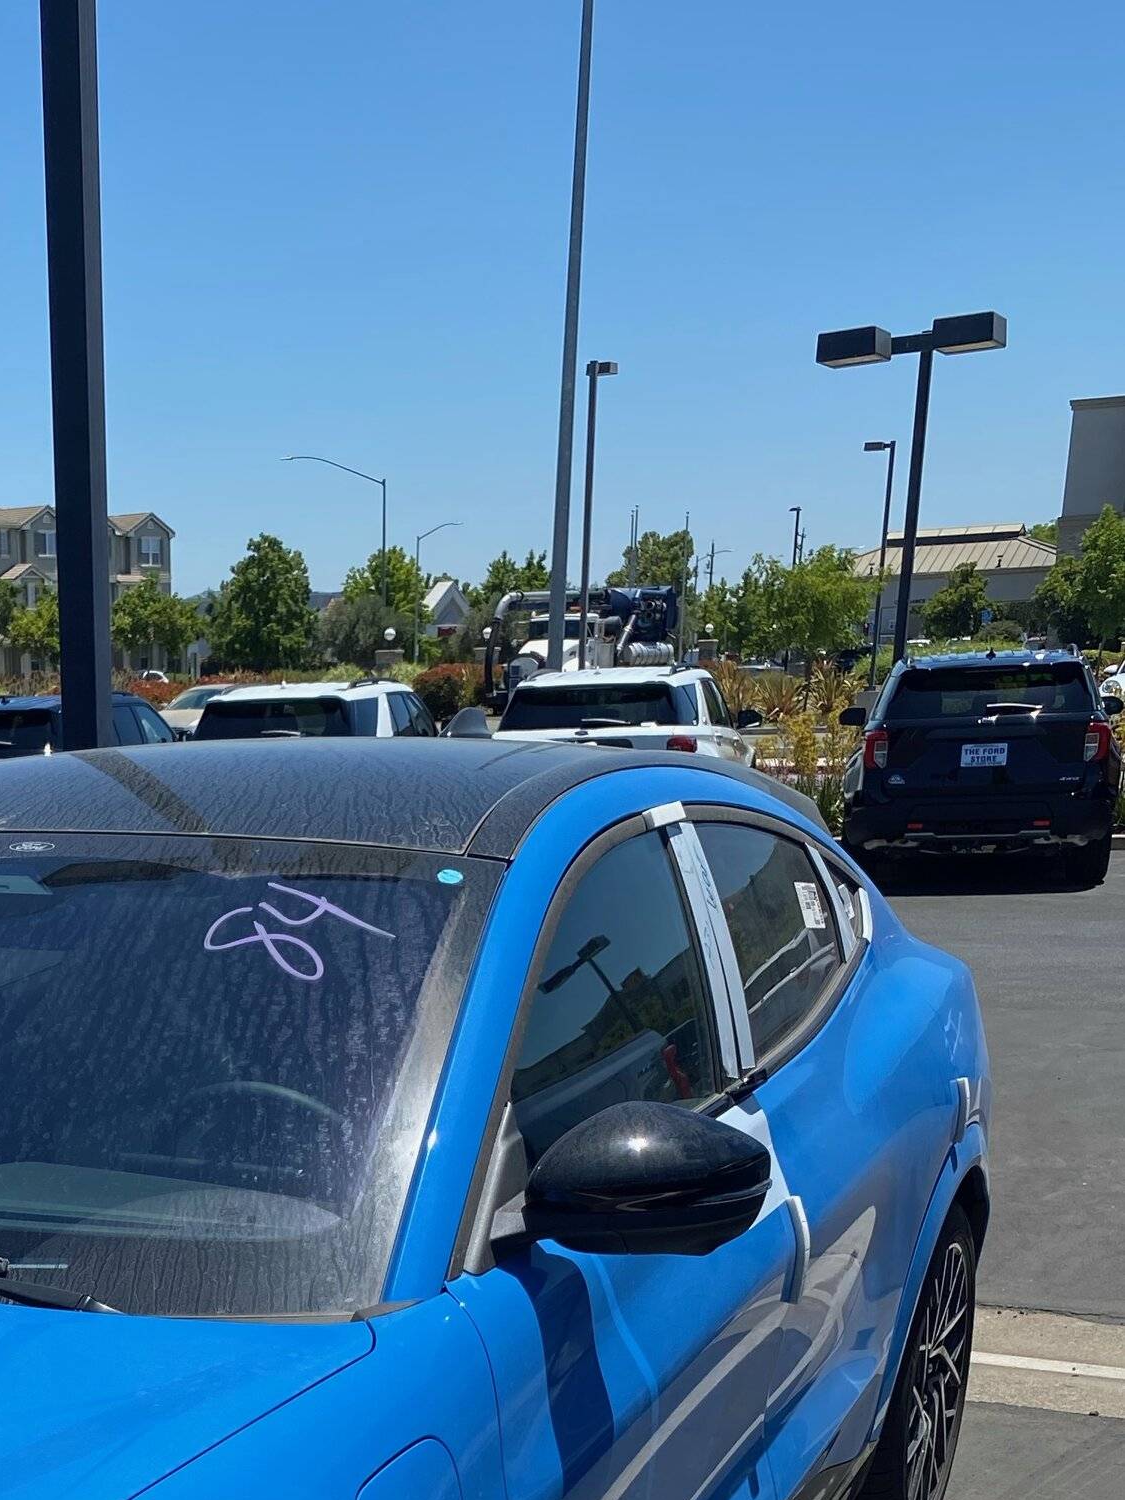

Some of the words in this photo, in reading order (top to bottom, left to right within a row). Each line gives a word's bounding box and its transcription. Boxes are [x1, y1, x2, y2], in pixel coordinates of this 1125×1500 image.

[983, 747, 1005, 755] FORD
[970, 755, 998, 763] STORE
[203, 882, 397, 981] 84
